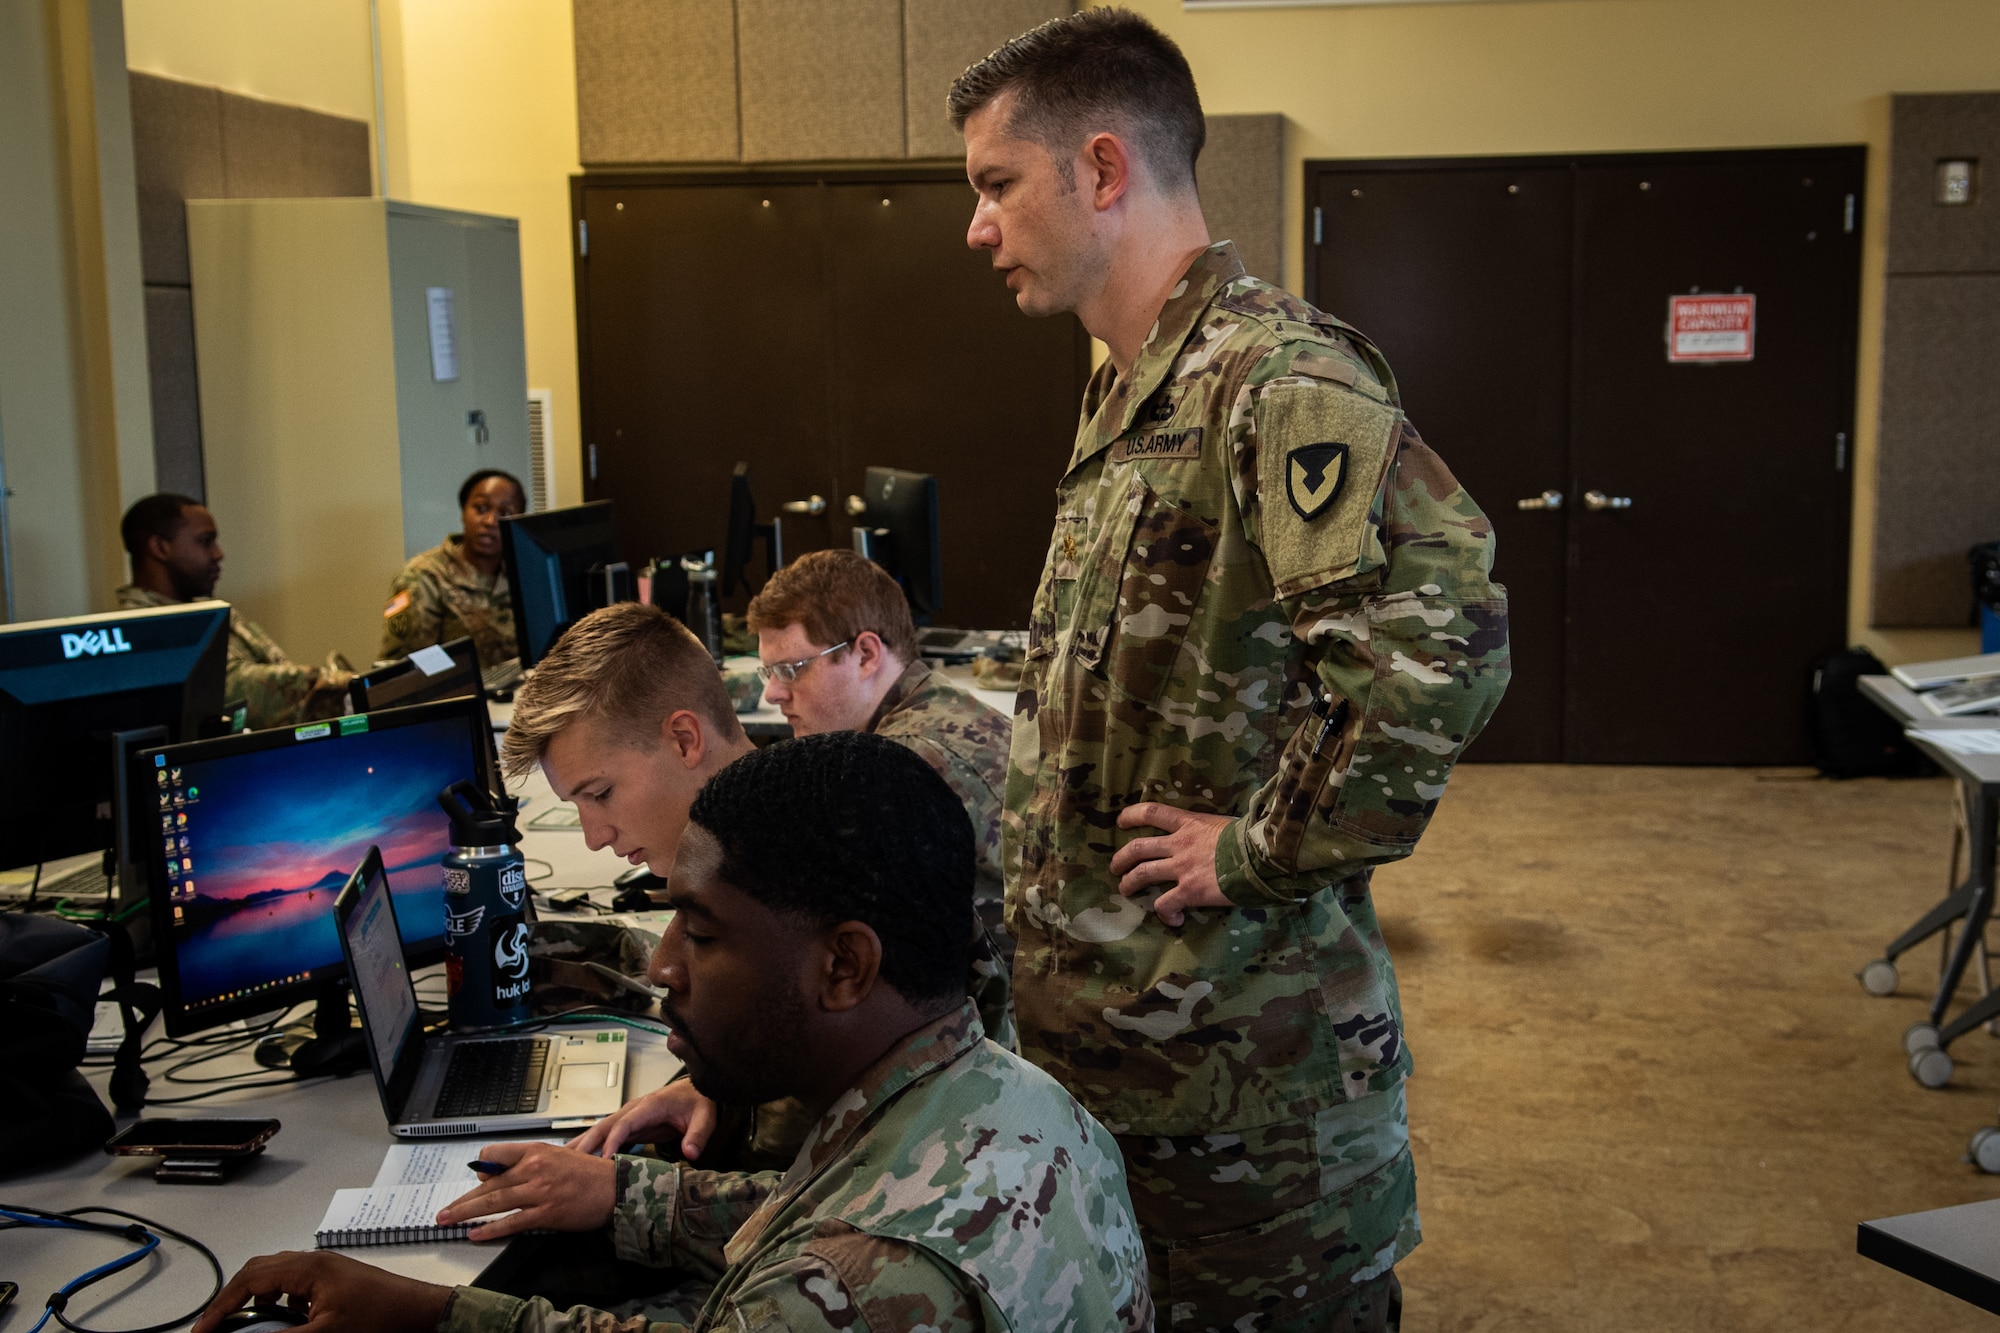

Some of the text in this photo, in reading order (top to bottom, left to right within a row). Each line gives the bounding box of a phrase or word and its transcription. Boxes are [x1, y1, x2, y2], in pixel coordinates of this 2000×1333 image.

[1679, 315, 1744, 329] CAPACITY
[60, 627, 132, 659] DELL
[445, 918, 465, 932] GLE
[496, 983, 521, 1000] huk
